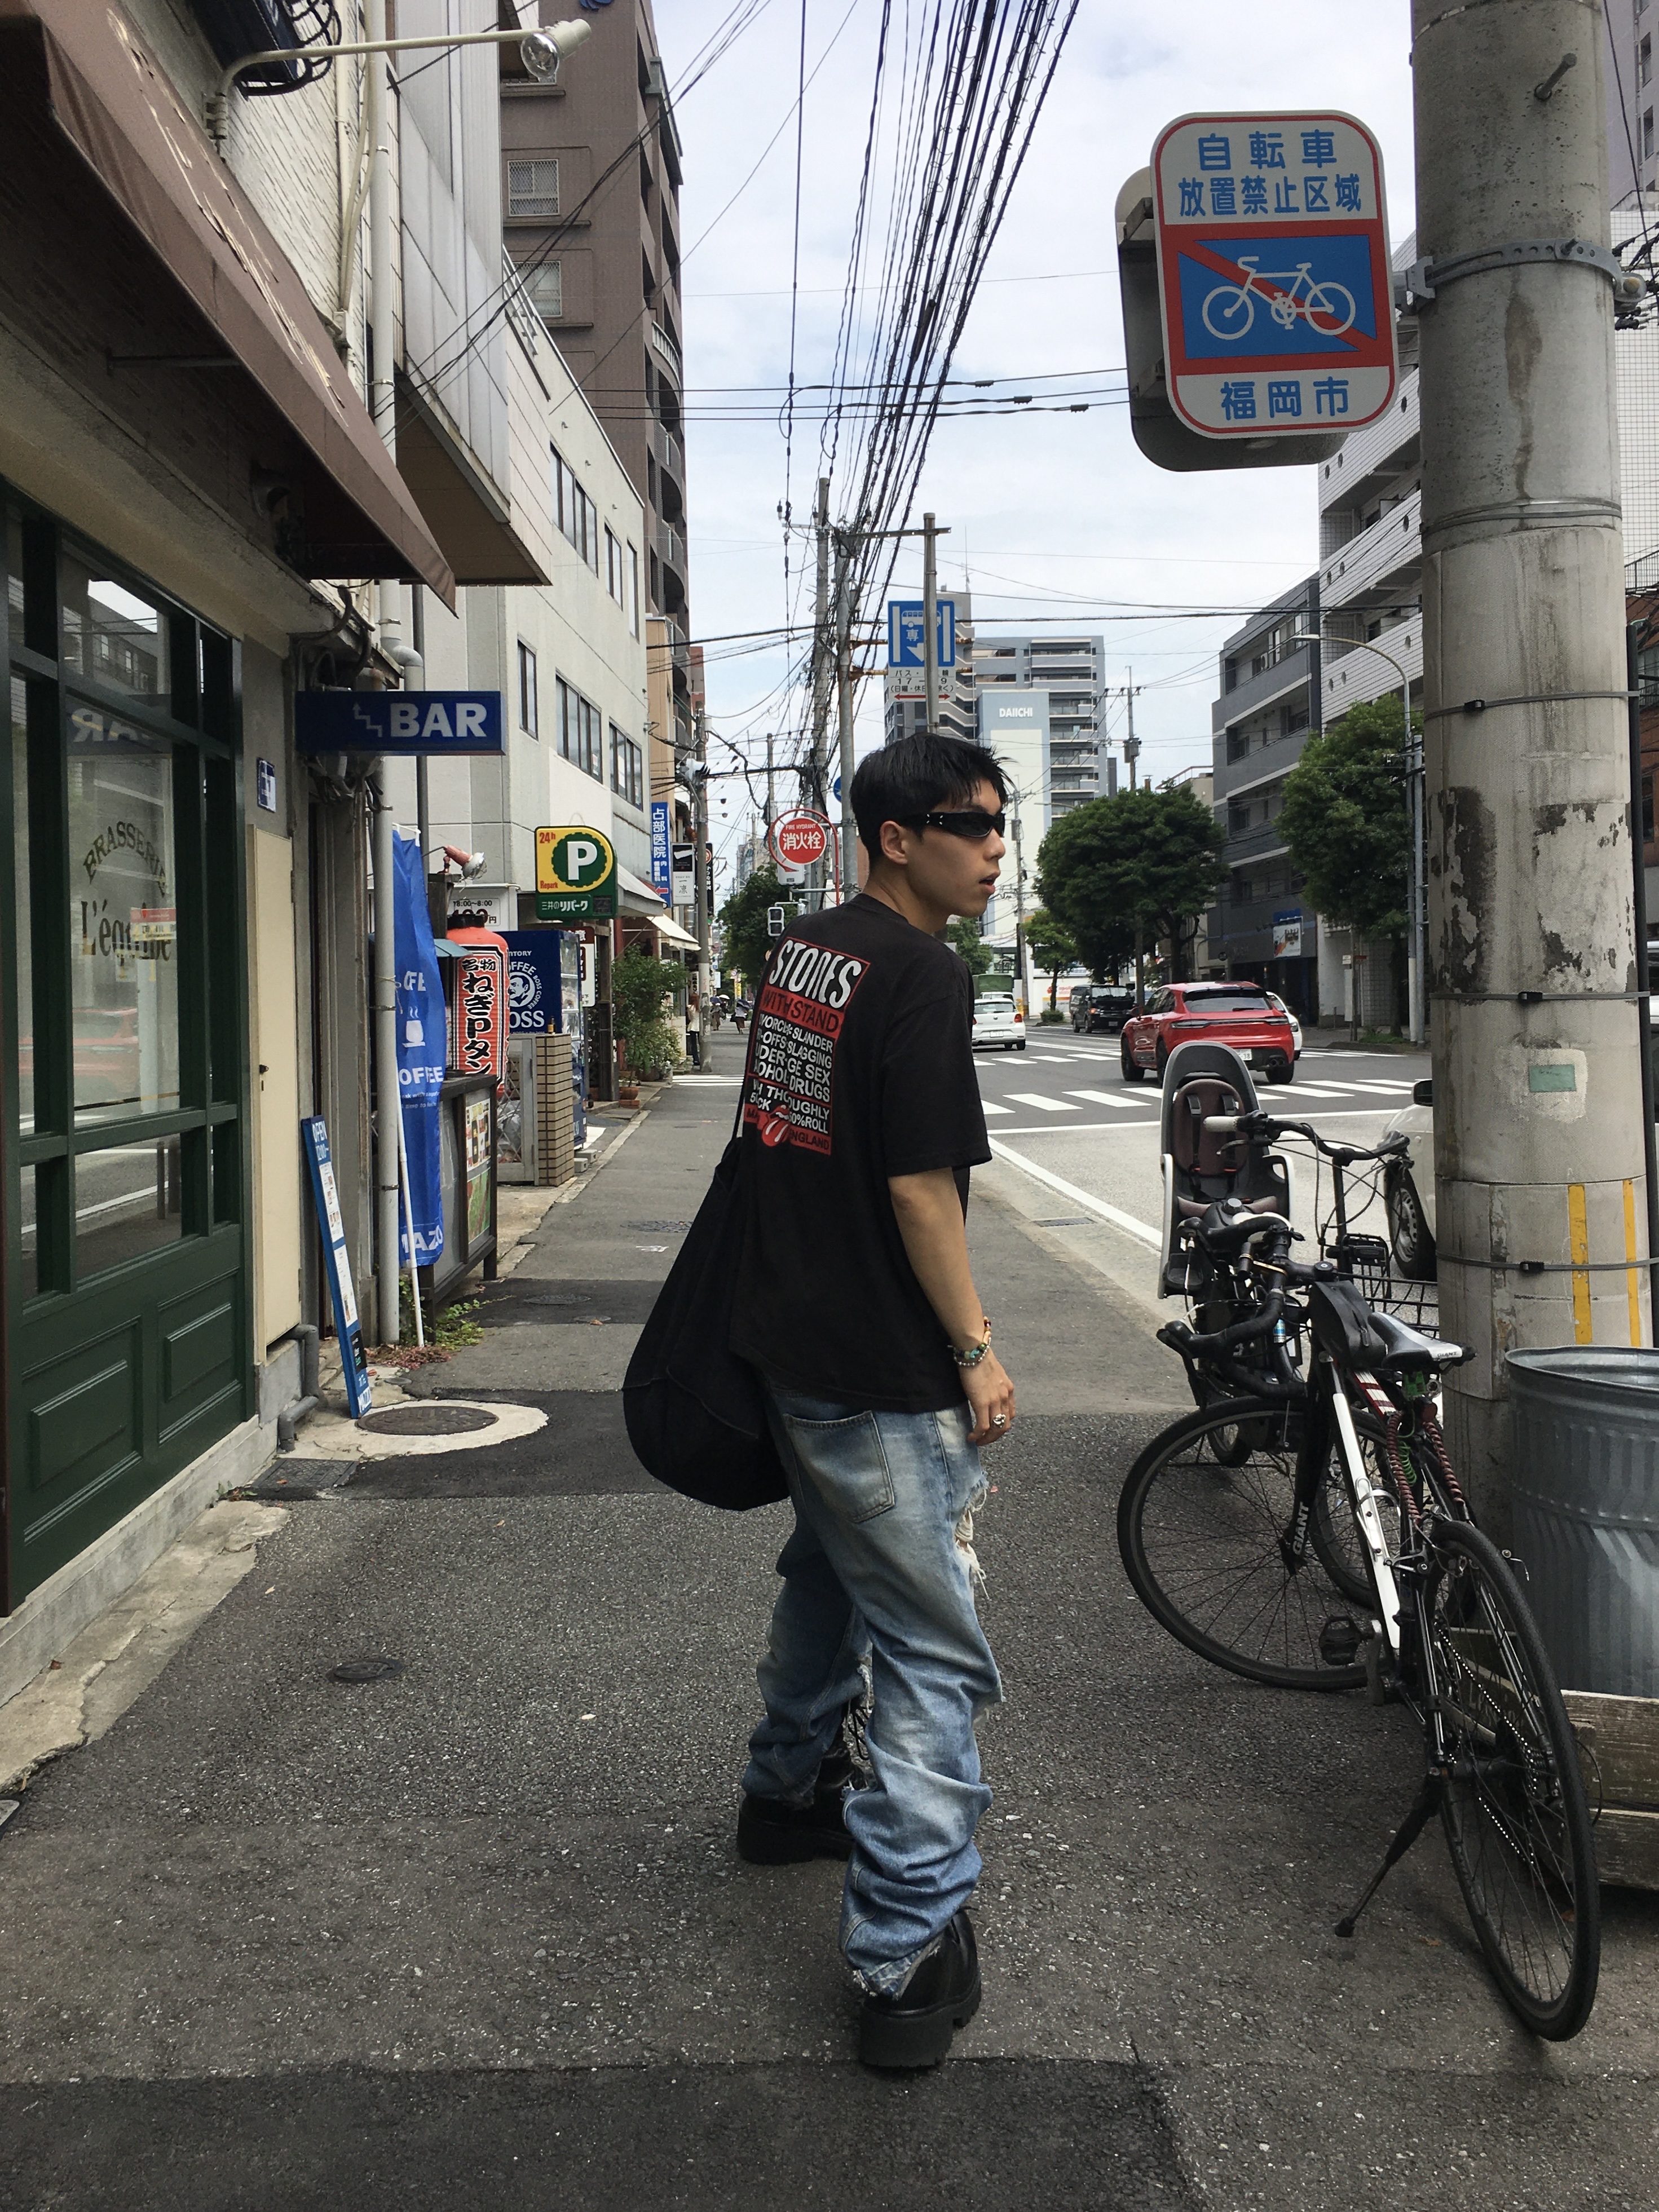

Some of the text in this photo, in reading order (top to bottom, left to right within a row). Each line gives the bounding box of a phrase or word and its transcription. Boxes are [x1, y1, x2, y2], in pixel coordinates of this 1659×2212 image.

[1198, 129, 1337, 171] 自転車
[1178, 173, 1362, 217] 放置禁止区域
[1220, 376, 1349, 421] 福岡市
[906, 629, 919, 641] 専
[390, 703, 487, 737] BAR
[999, 708, 1033, 718] DAIICHI
[540, 832, 555, 844] 24h
[652, 808, 667, 858] 占部医院
[782, 831, 822, 850] 消火栓
[83, 821, 166, 898] BRASSERIE
[567, 841, 598, 880] P
[540, 880, 558, 890] Repark
[541, 900, 588, 911] 三井のリパーク
[462, 958, 496, 971] 名物
[769, 939, 862, 1009] STONES
[528, 975, 542, 1009] BOSS COFFEE
[510, 1010, 545, 1028] OSS
[792, 1027, 833, 1053] SLANDER
[787, 1041, 832, 1069] SLAGGING
[399, 1066, 444, 1085] OFFEE
[789, 1075, 830, 1102] DRUGS
[805, 1064, 830, 1086] SEX
[1292, 1501, 1309, 1555] GIANT
